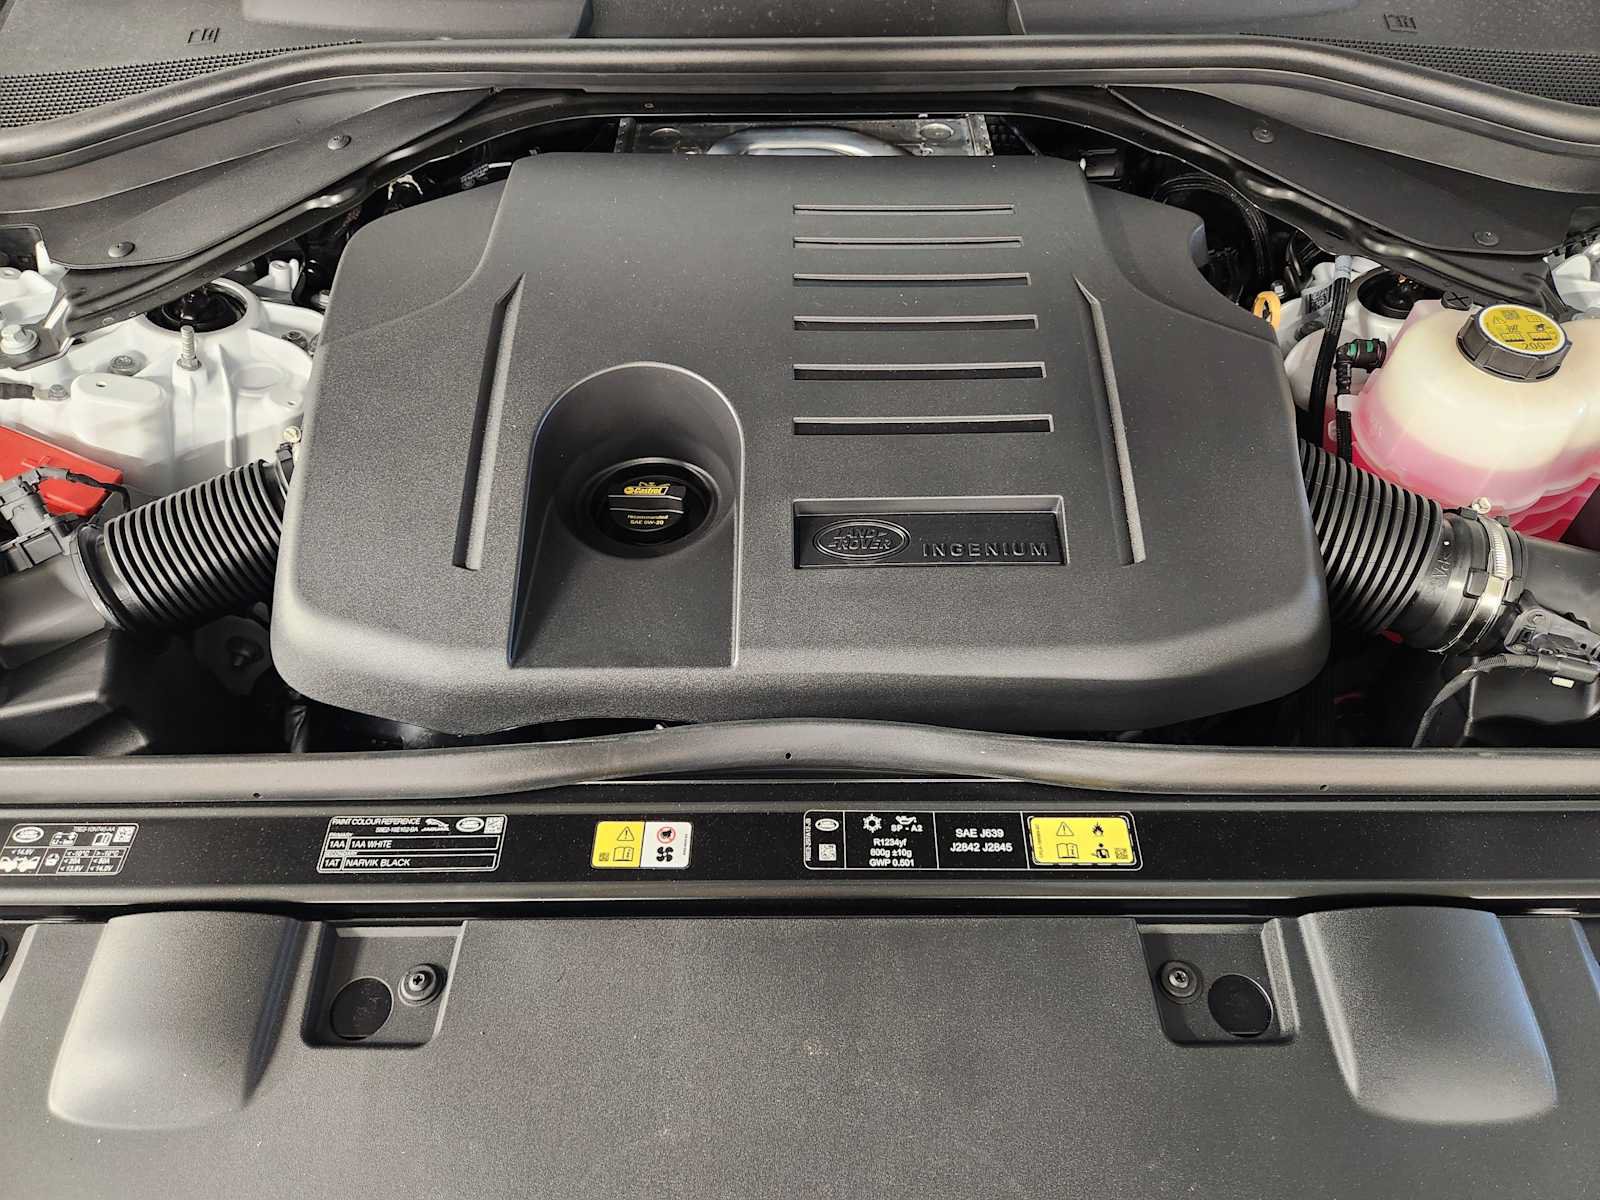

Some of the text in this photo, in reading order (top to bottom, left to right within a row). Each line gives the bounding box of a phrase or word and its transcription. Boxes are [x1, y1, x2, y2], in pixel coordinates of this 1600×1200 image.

[837, 538, 890, 550] ROVER
[922, 542, 1048, 557] INGENIUM
[955, 828, 1005, 838] SAE J639
[329, 840, 346, 848] 1AA
[351, 840, 392, 848] 1AA WHITE
[873, 838, 907, 848] R1234yf
[949, 842, 1013, 853] J2842 J2845
[324, 859, 341, 867] 1AT
[345, 859, 411, 867] NARVIK BLACK
[869, 858, 915, 867] GWP 0.501
